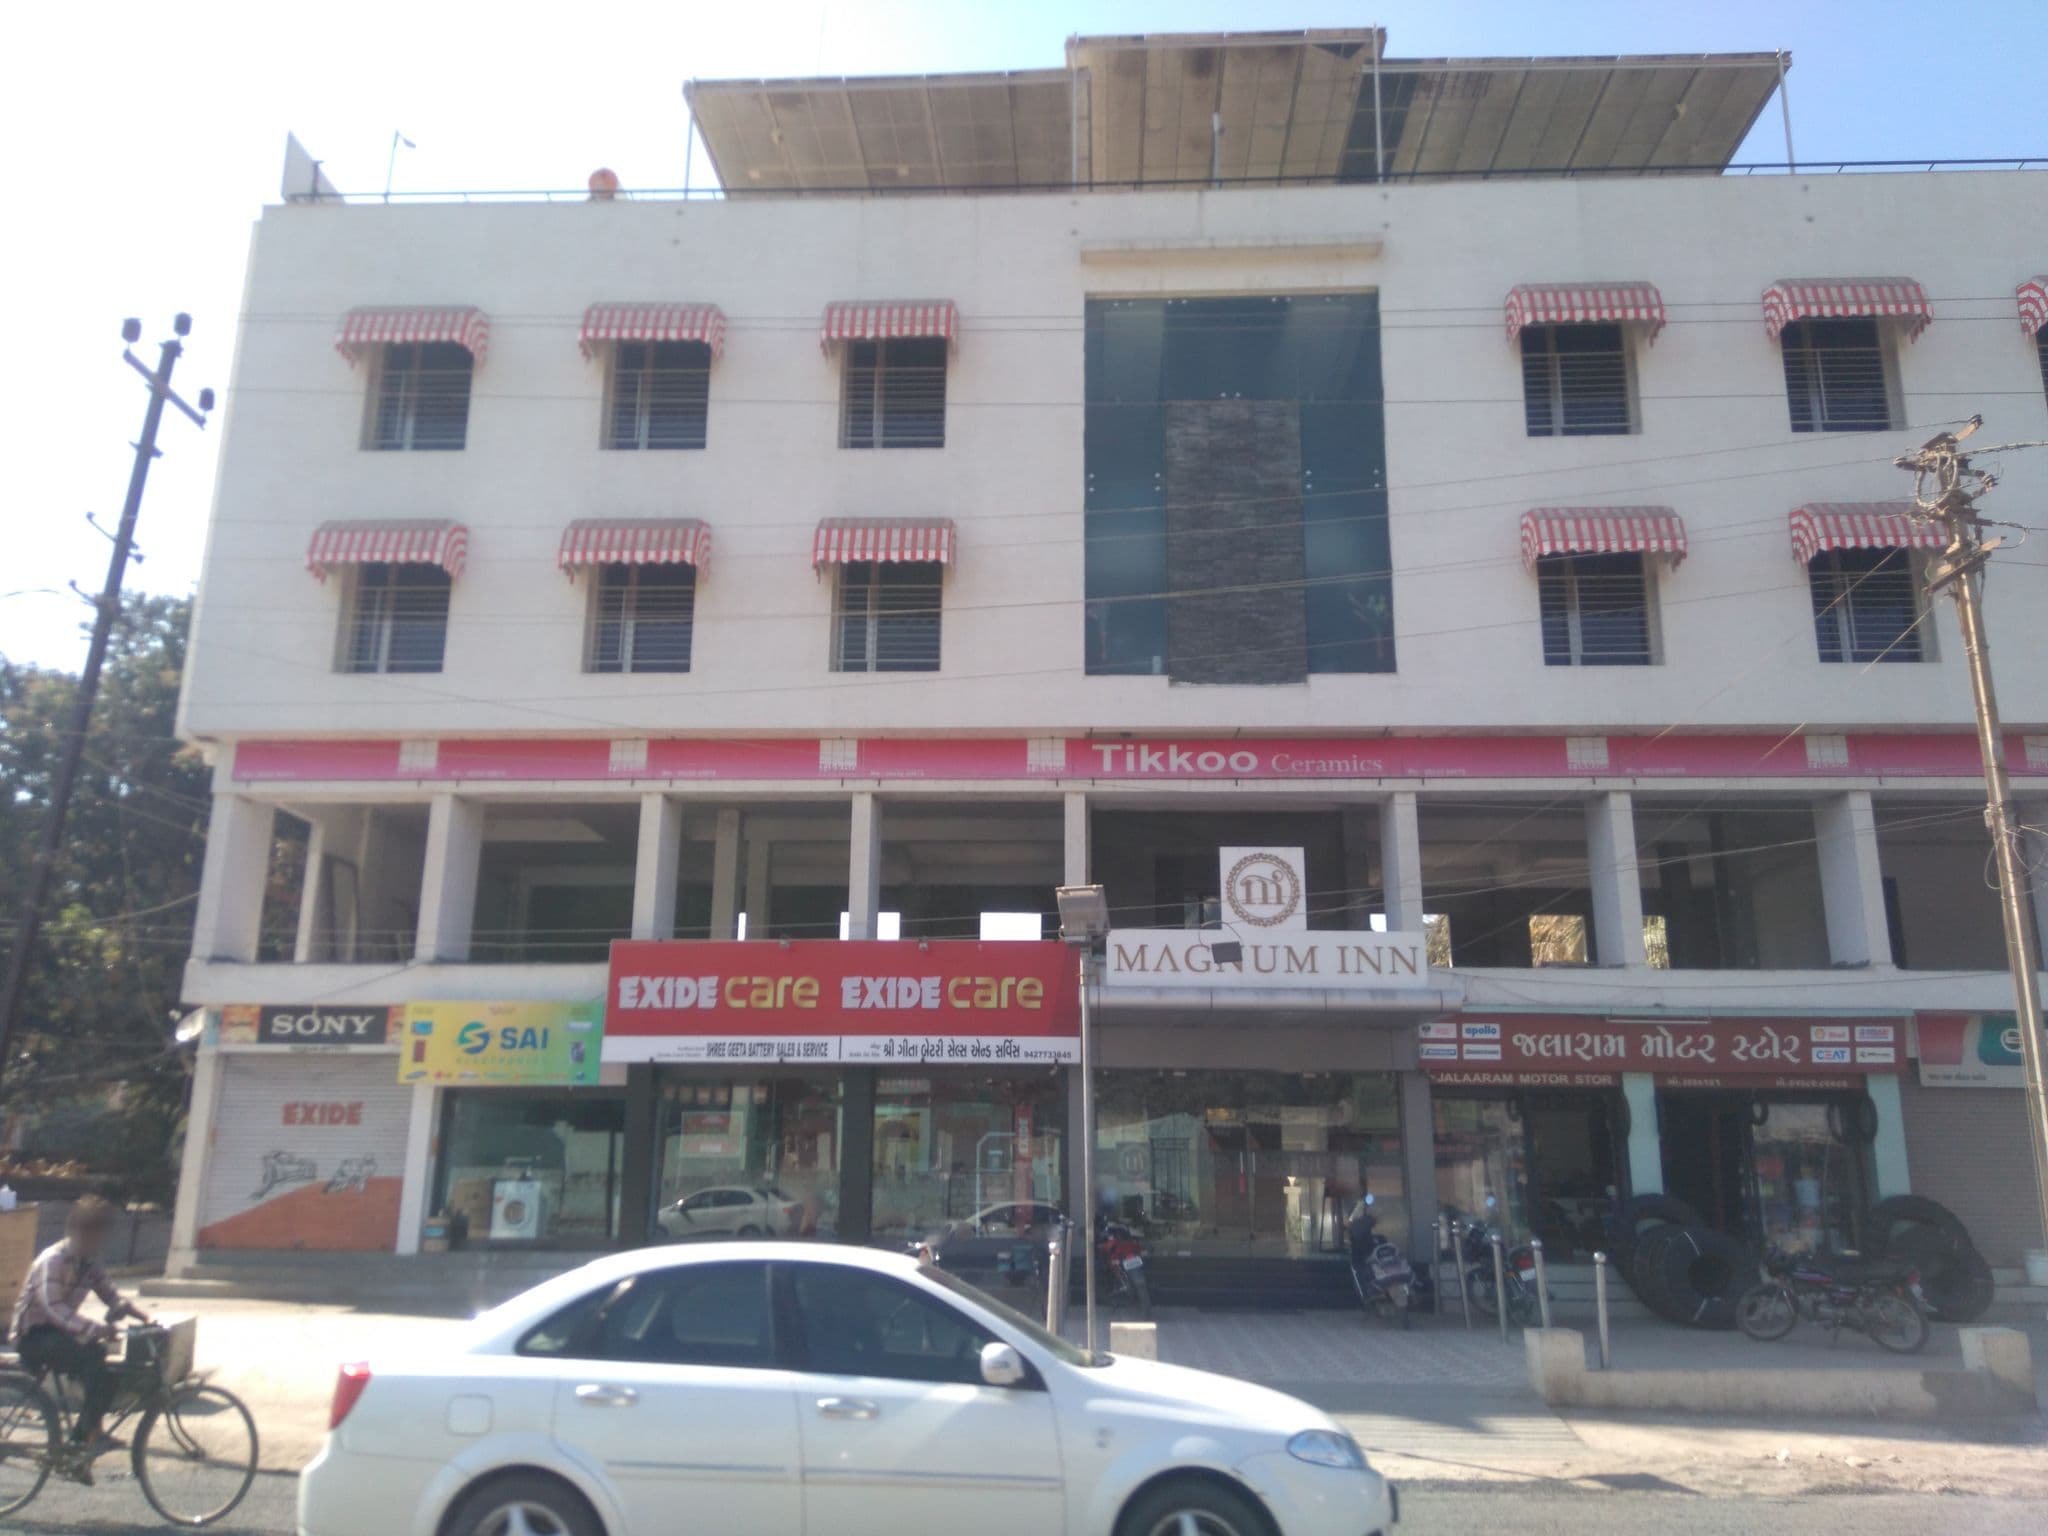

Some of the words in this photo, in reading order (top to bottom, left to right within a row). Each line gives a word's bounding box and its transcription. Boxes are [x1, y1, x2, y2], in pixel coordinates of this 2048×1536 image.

[1092, 743, 1259, 773] Tikkoo
[1271, 752, 1382, 773] Ceramics
[1336, 945, 1419, 976] INN
[618, 975, 719, 1009] EXIDE
[724, 976, 820, 1009] care
[840, 975, 942, 1009] EXIDE
[947, 976, 1044, 1009] care
[271, 1014, 376, 1035] SONY
[1465, 1024, 1497, 1038] apollo
[500, 1026, 550, 1050] SAI
[883, 1037, 895, 1058] શ્રી
[898, 1037, 918, 1058] ગીતા
[1511, 1032, 1626, 1062] જલારામ
[1641, 1025, 1717, 1064] મોટર
[1731, 1026, 1801, 1064] સ્ટોર
[706, 1042, 726, 1057] SHREE
[728, 1042, 746, 1057] GEETA
[748, 1042, 775, 1057] BATTERY
[776, 1042, 796, 1057] SALES
[803, 1042, 828, 1057] SERVICE
[1816, 1049, 1847, 1060] CEAT
[1436, 1072, 1514, 1084] JALAARAM
[1519, 1073, 1570, 1085] MOTOR
[282, 1102, 365, 1127] EXIDE
